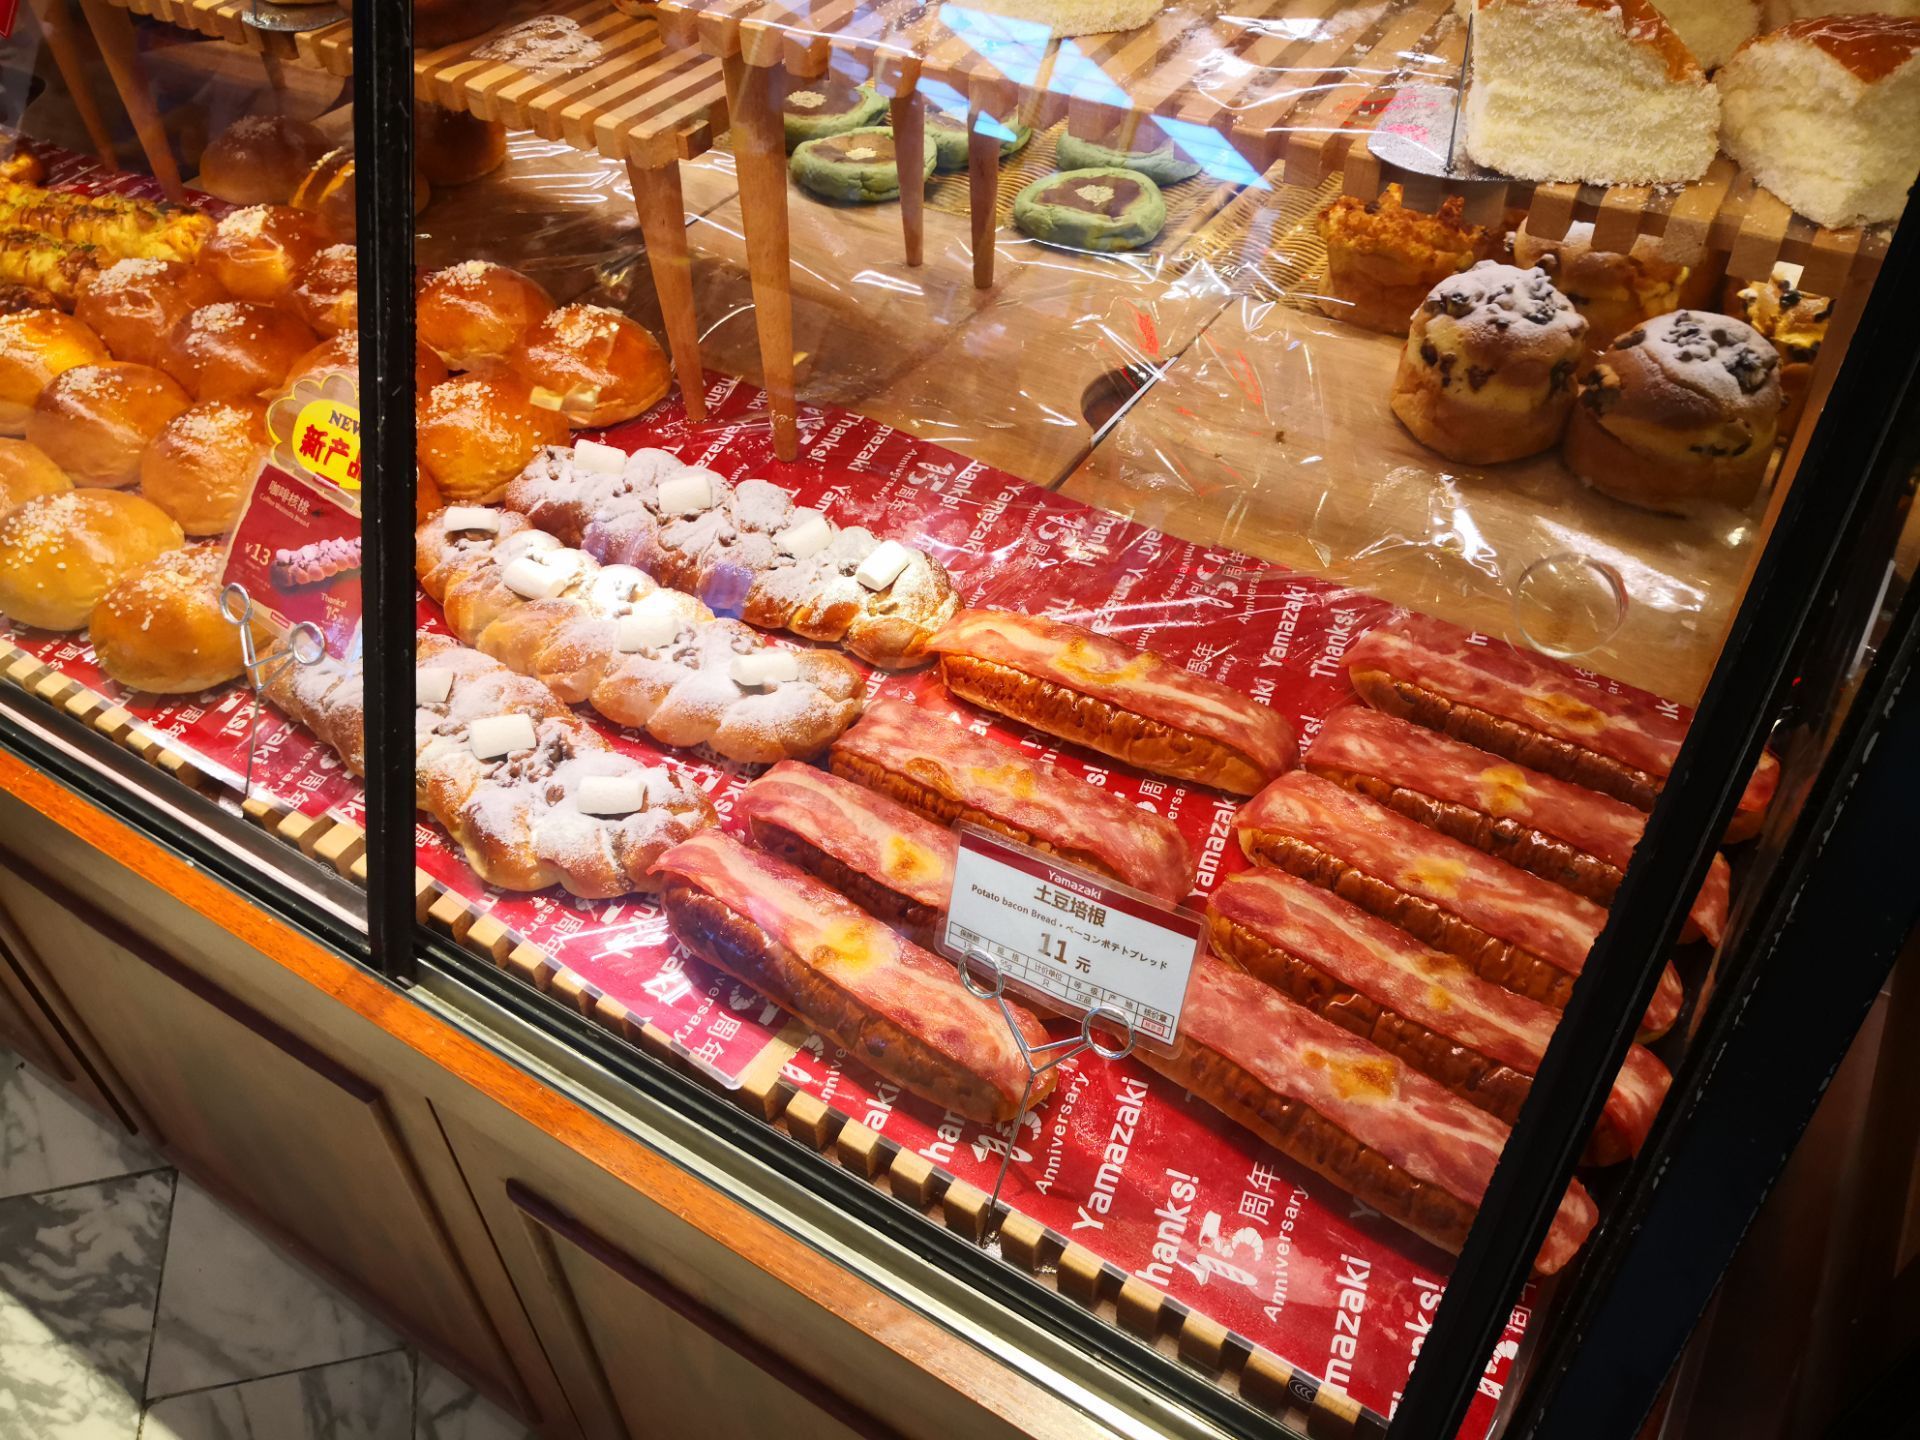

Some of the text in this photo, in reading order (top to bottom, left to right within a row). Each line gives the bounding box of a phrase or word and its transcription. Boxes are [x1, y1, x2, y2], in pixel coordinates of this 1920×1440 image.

[806, 412, 865, 463] Thanks!
[847, 424, 895, 473] mazaki
[871, 448, 919, 502] Anniversary
[1236, 559, 1271, 625] Anniversary
[1258, 585, 1308, 669] Yamazaki
[1309, 607, 1358, 678] Thanks!
[971, 884, 1057, 927] Potato bacon Bread
[1033, 885, 1107, 928] 土豆培根
[1048, 870, 1102, 900] Yamazaki
[1037, 932, 1092, 974] 11 元
[692, 1011, 743, 1065] 周年
[1034, 1071, 1090, 1196] Anniversary
[1071, 1076, 1150, 1231] Yamazaki
[1237, 1160, 1281, 1226] 周年
[1135, 1168, 1201, 1287] hanks!
[1262, 1184, 1310, 1323] Anniversary
[1323, 1253, 1372, 1397] mazaki
